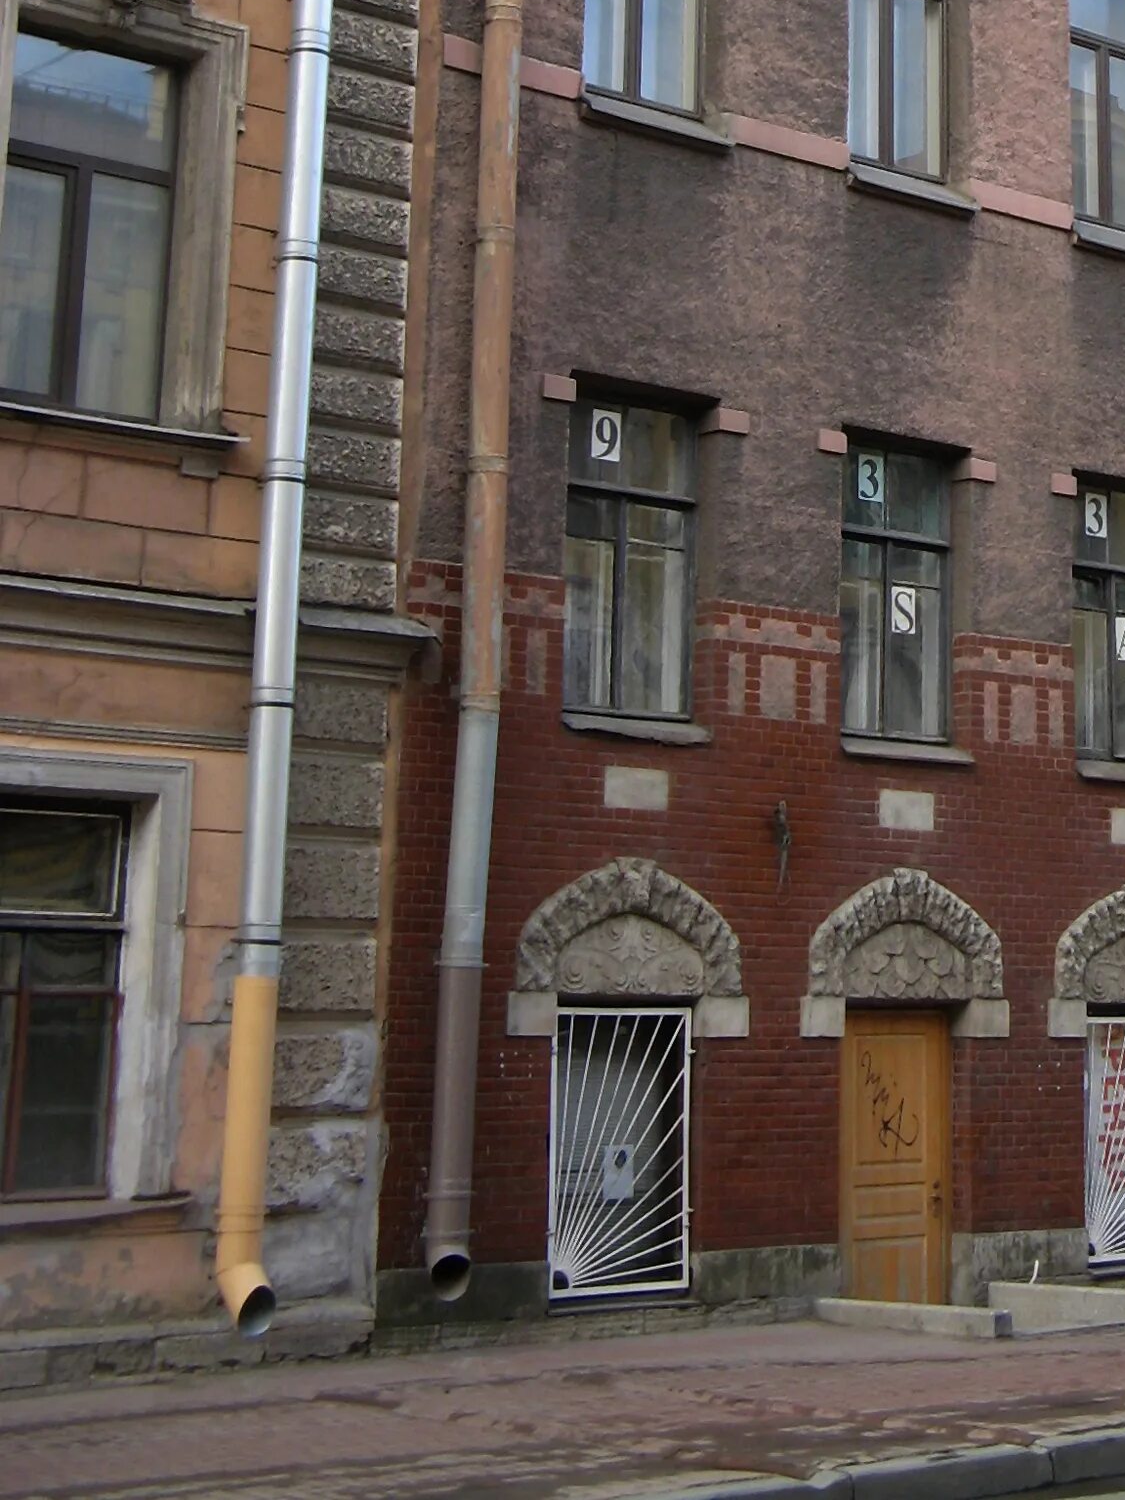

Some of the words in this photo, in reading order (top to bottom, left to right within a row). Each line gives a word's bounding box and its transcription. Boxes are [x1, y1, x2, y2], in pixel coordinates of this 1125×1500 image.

[595, 416, 618, 458] 9
[860, 459, 879, 498] 3
[1087, 498, 1103, 534] 3
[894, 591, 914, 633] S
